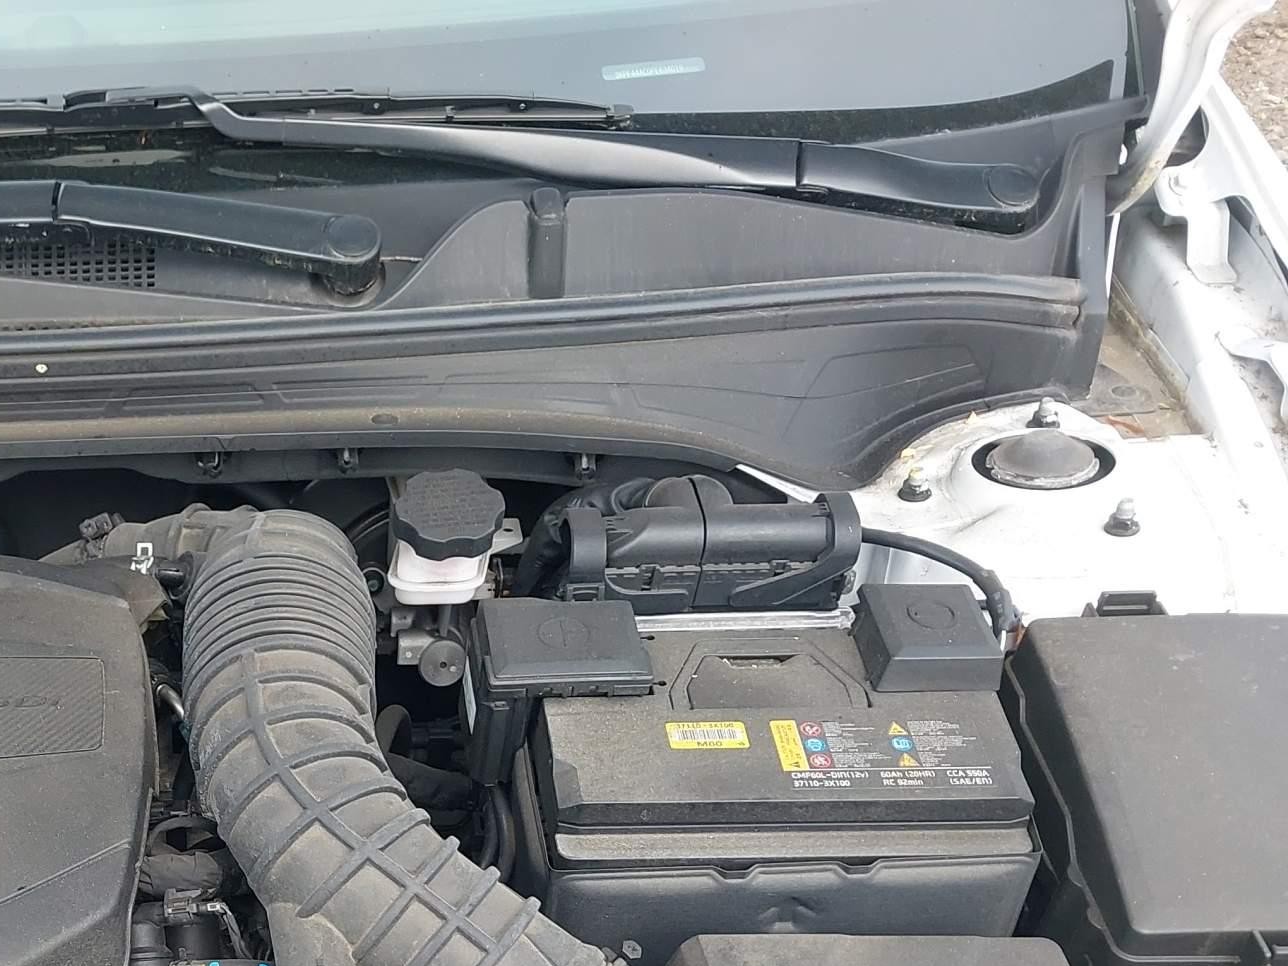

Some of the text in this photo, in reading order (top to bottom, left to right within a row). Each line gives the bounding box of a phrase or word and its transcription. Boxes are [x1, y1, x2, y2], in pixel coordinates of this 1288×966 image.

[946, 769, 966, 778] CCA
[793, 778, 852, 788] 37110-3X100
[882, 778, 896, 787] RC
